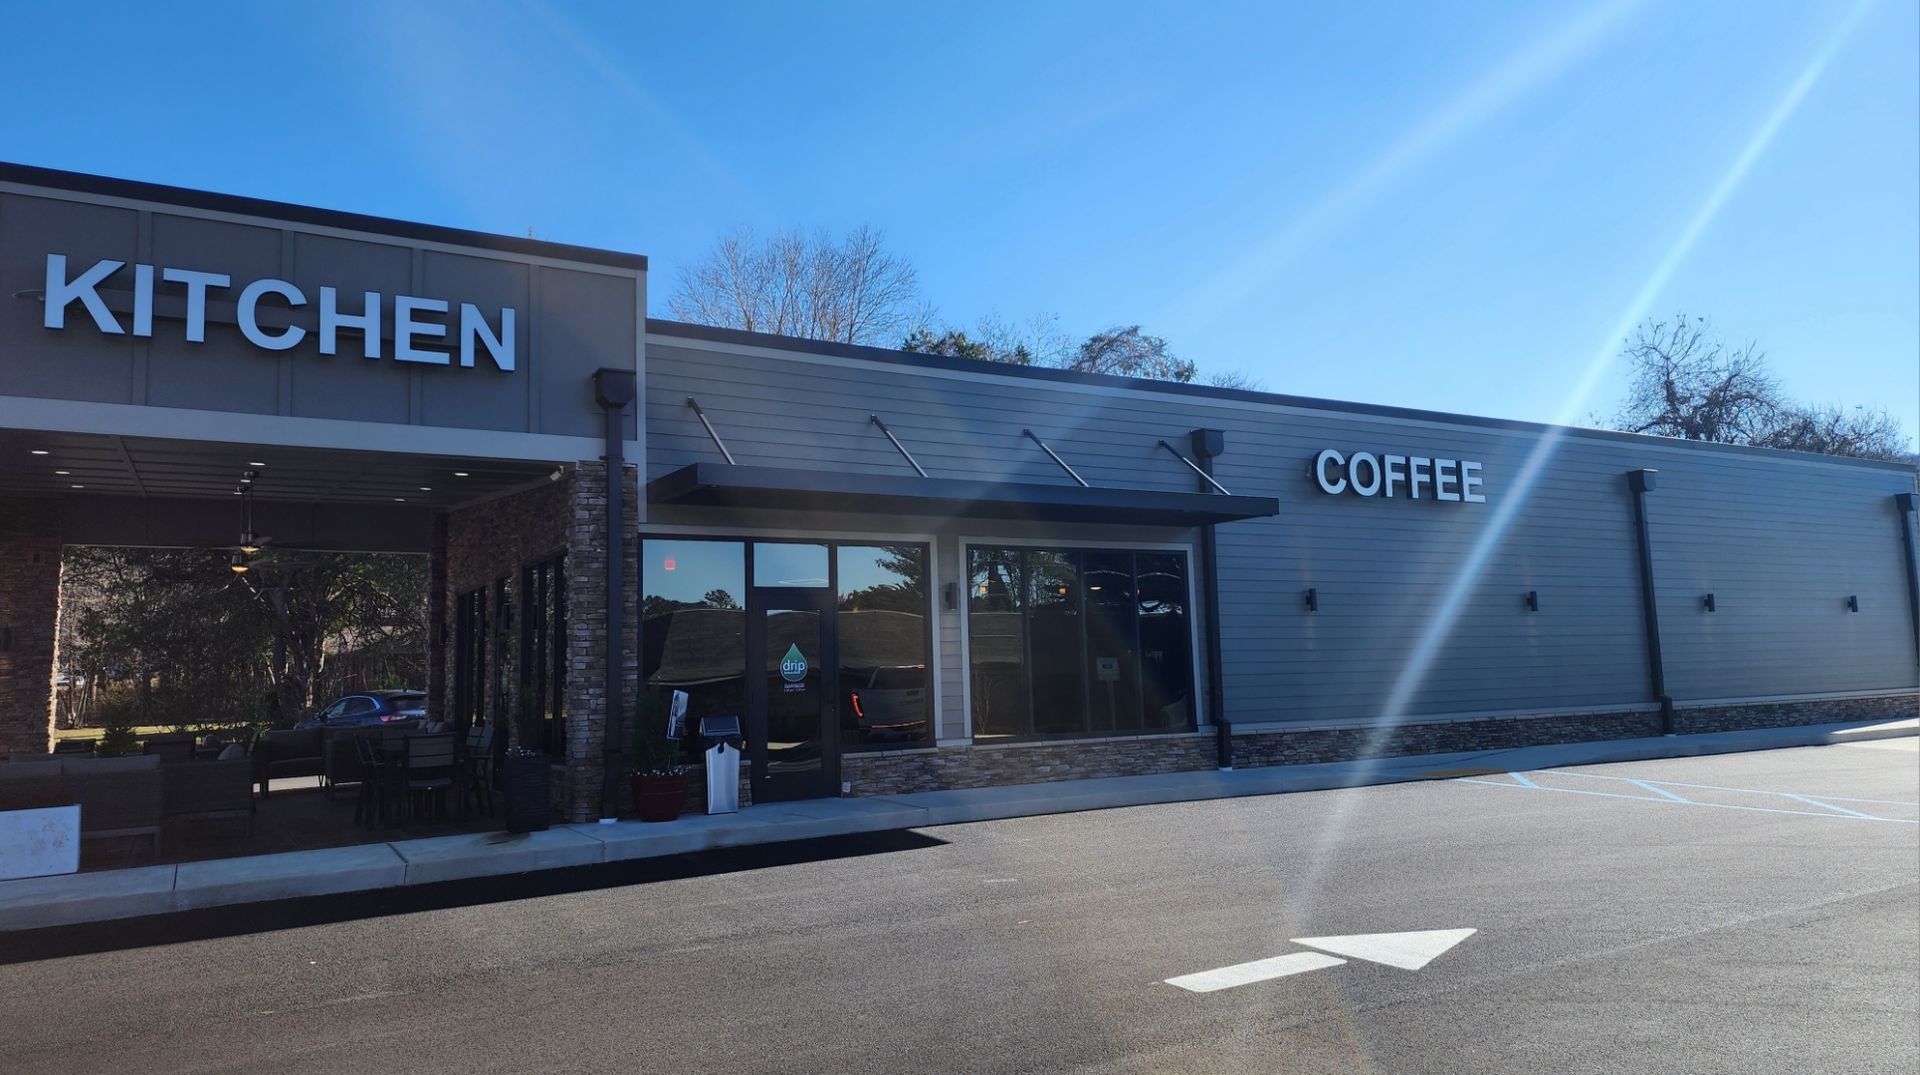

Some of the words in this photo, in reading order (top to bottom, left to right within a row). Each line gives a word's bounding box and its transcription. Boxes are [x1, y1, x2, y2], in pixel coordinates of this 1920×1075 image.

[44, 253, 516, 371] KITCHEN
[1314, 448, 1486, 503] COFFEE
[782, 659, 806, 674] drip
